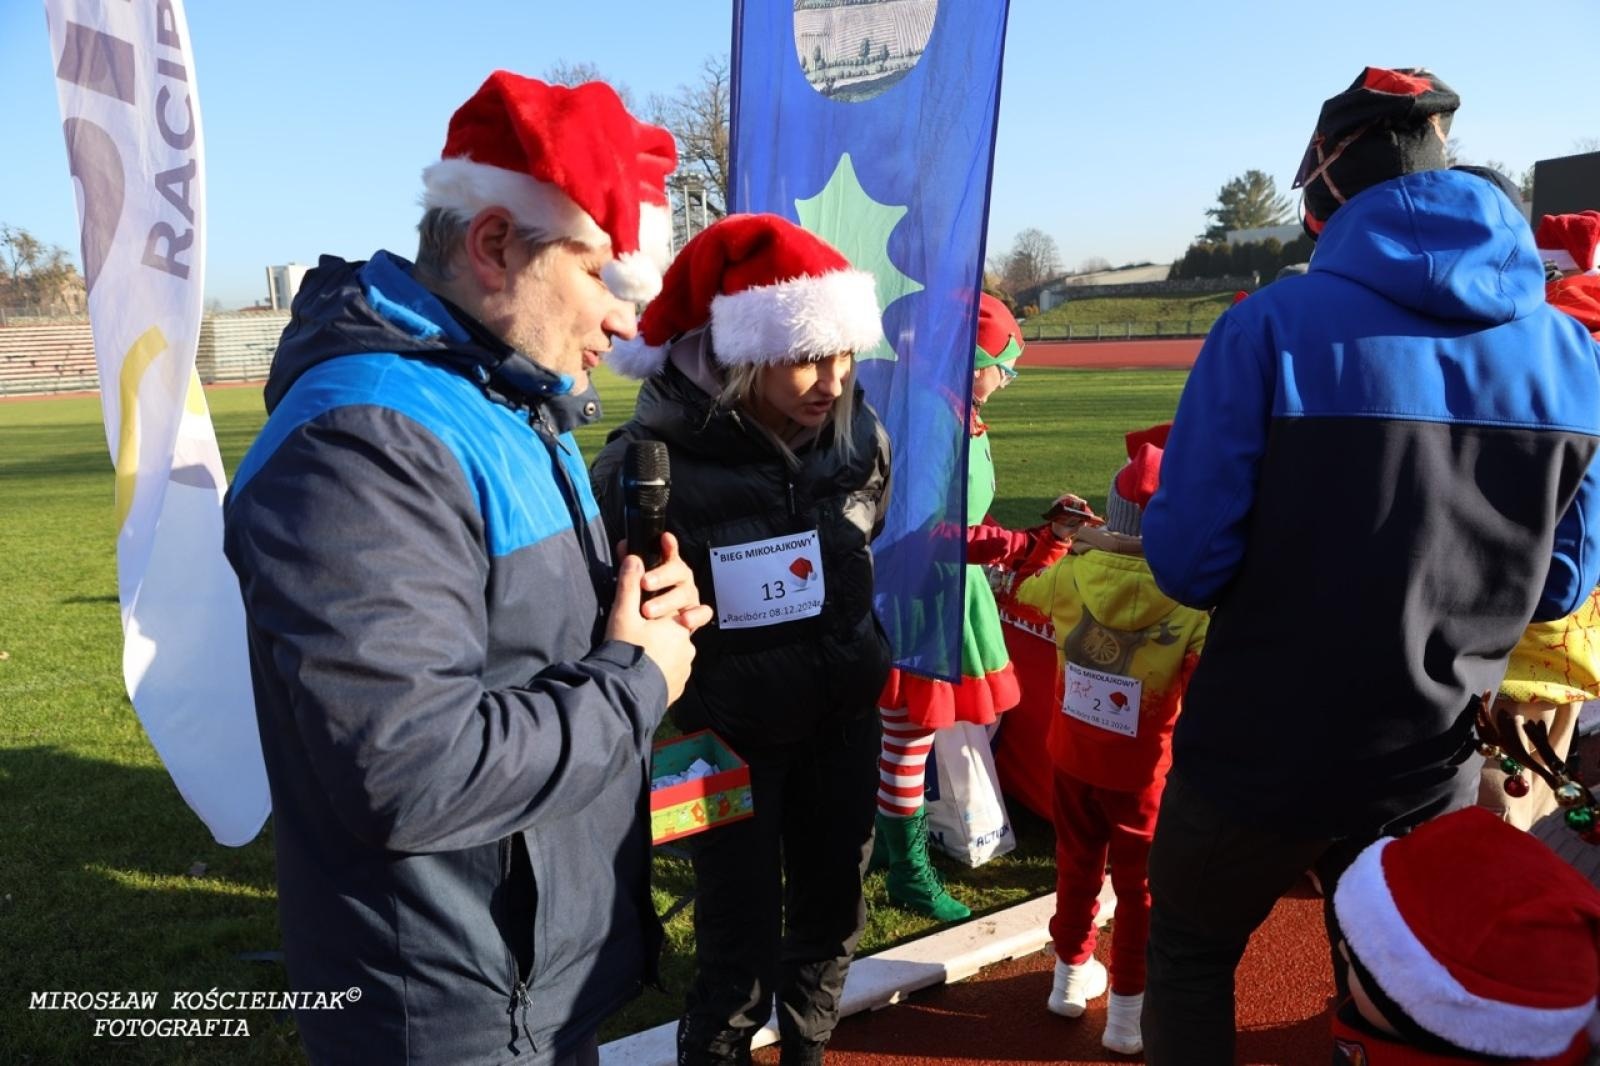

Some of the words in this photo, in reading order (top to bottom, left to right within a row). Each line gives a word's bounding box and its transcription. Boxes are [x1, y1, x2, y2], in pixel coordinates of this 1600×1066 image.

[720, 550, 743, 563] BIEG
[745, 537, 813, 559] MIKOŁAJKOWY
[761, 580, 786, 601] 13
[727, 608, 767, 623] Racibórz
[1092, 697, 1102, 712] 2
[975, 823, 1010, 848] ACTION
